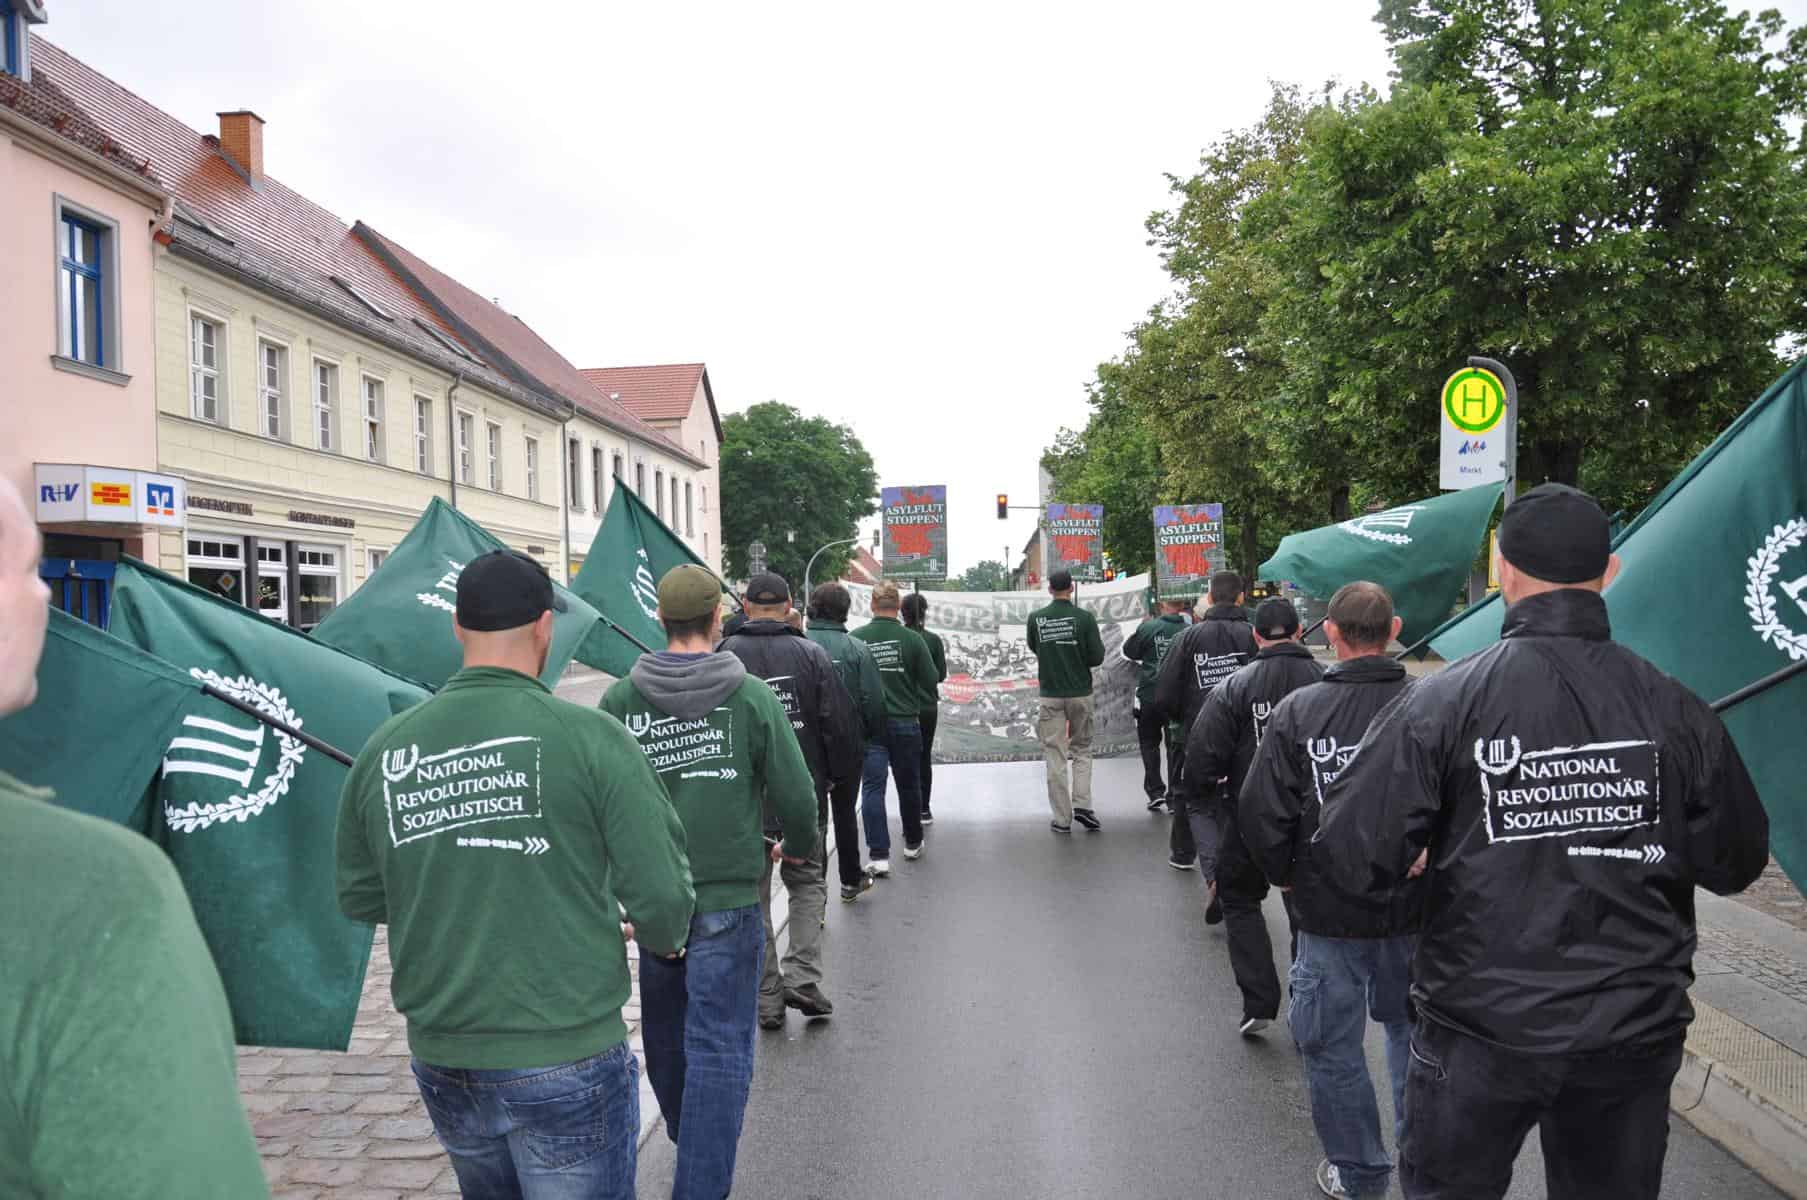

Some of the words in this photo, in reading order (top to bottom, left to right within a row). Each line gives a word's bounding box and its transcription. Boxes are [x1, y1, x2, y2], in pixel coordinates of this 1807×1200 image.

[1462, 383, 1486, 418] H
[41, 483, 79, 503] R+V
[887, 503, 944, 515] ASYLFLUT
[887, 514, 944, 525] STOPPEN!
[1052, 519, 1101, 528] ASYLFLUT
[1052, 527, 1101, 536] STOPPEN!
[1160, 521, 1219, 535] ASYLFLUT
[1160, 533, 1220, 545] STOPPEN!
[650, 717, 710, 738] NATIONAL
[640, 728, 726, 754] REVOLUTIONÄR
[649, 744, 721, 767] OZIALISTISCH
[416, 752, 505, 783] NATIONAL
[1519, 758, 1621, 780] NATIONAL
[396, 770, 529, 811] REVOLUTIONÄR
[1496, 778, 1649, 807] REVOLUTIONÄR
[402, 796, 524, 831] SOZIALISTISCH
[1503, 804, 1643, 830] SOZIALISTISCH
